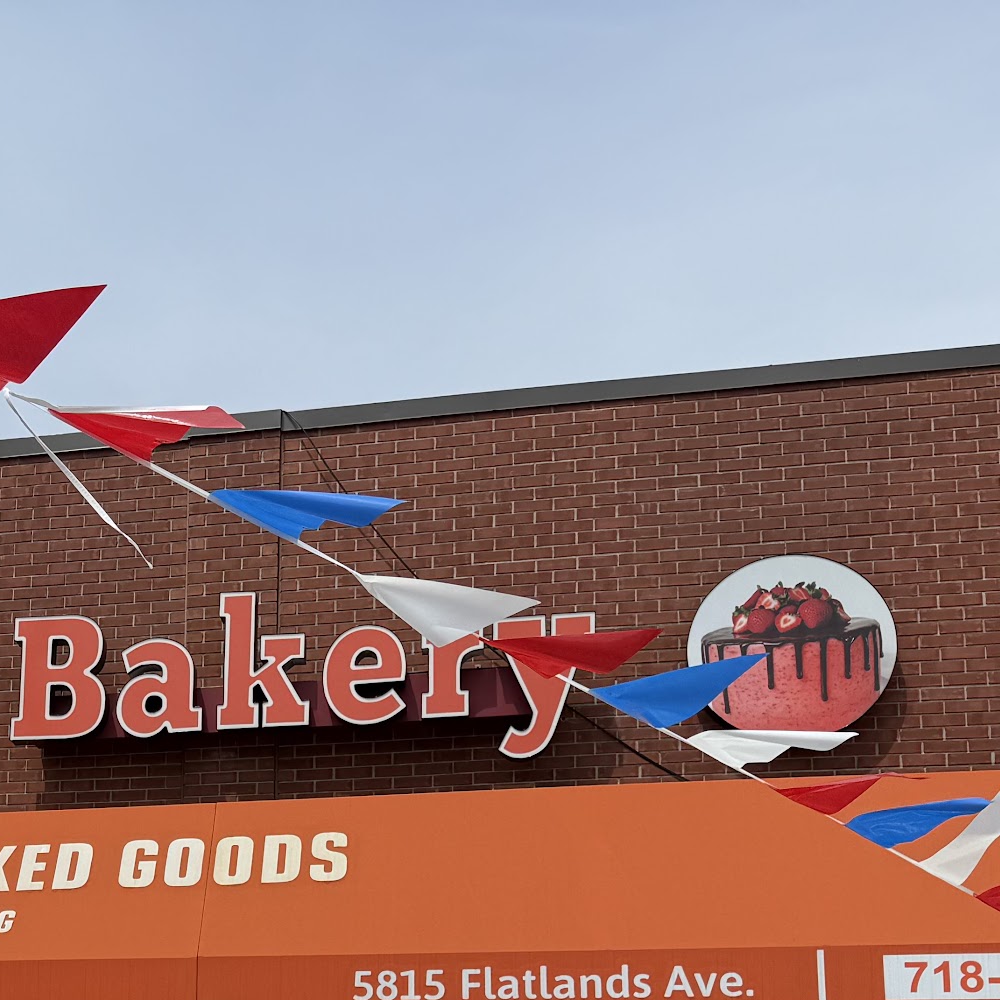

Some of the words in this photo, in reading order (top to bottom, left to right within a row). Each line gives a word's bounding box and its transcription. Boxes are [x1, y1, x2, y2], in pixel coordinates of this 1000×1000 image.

[10, 592, 596, 759] Bakery
[117, 831, 350, 888] GOODS
[461, 963, 652, 1000] Flatlands
[664, 963, 756, 998] Ave.
